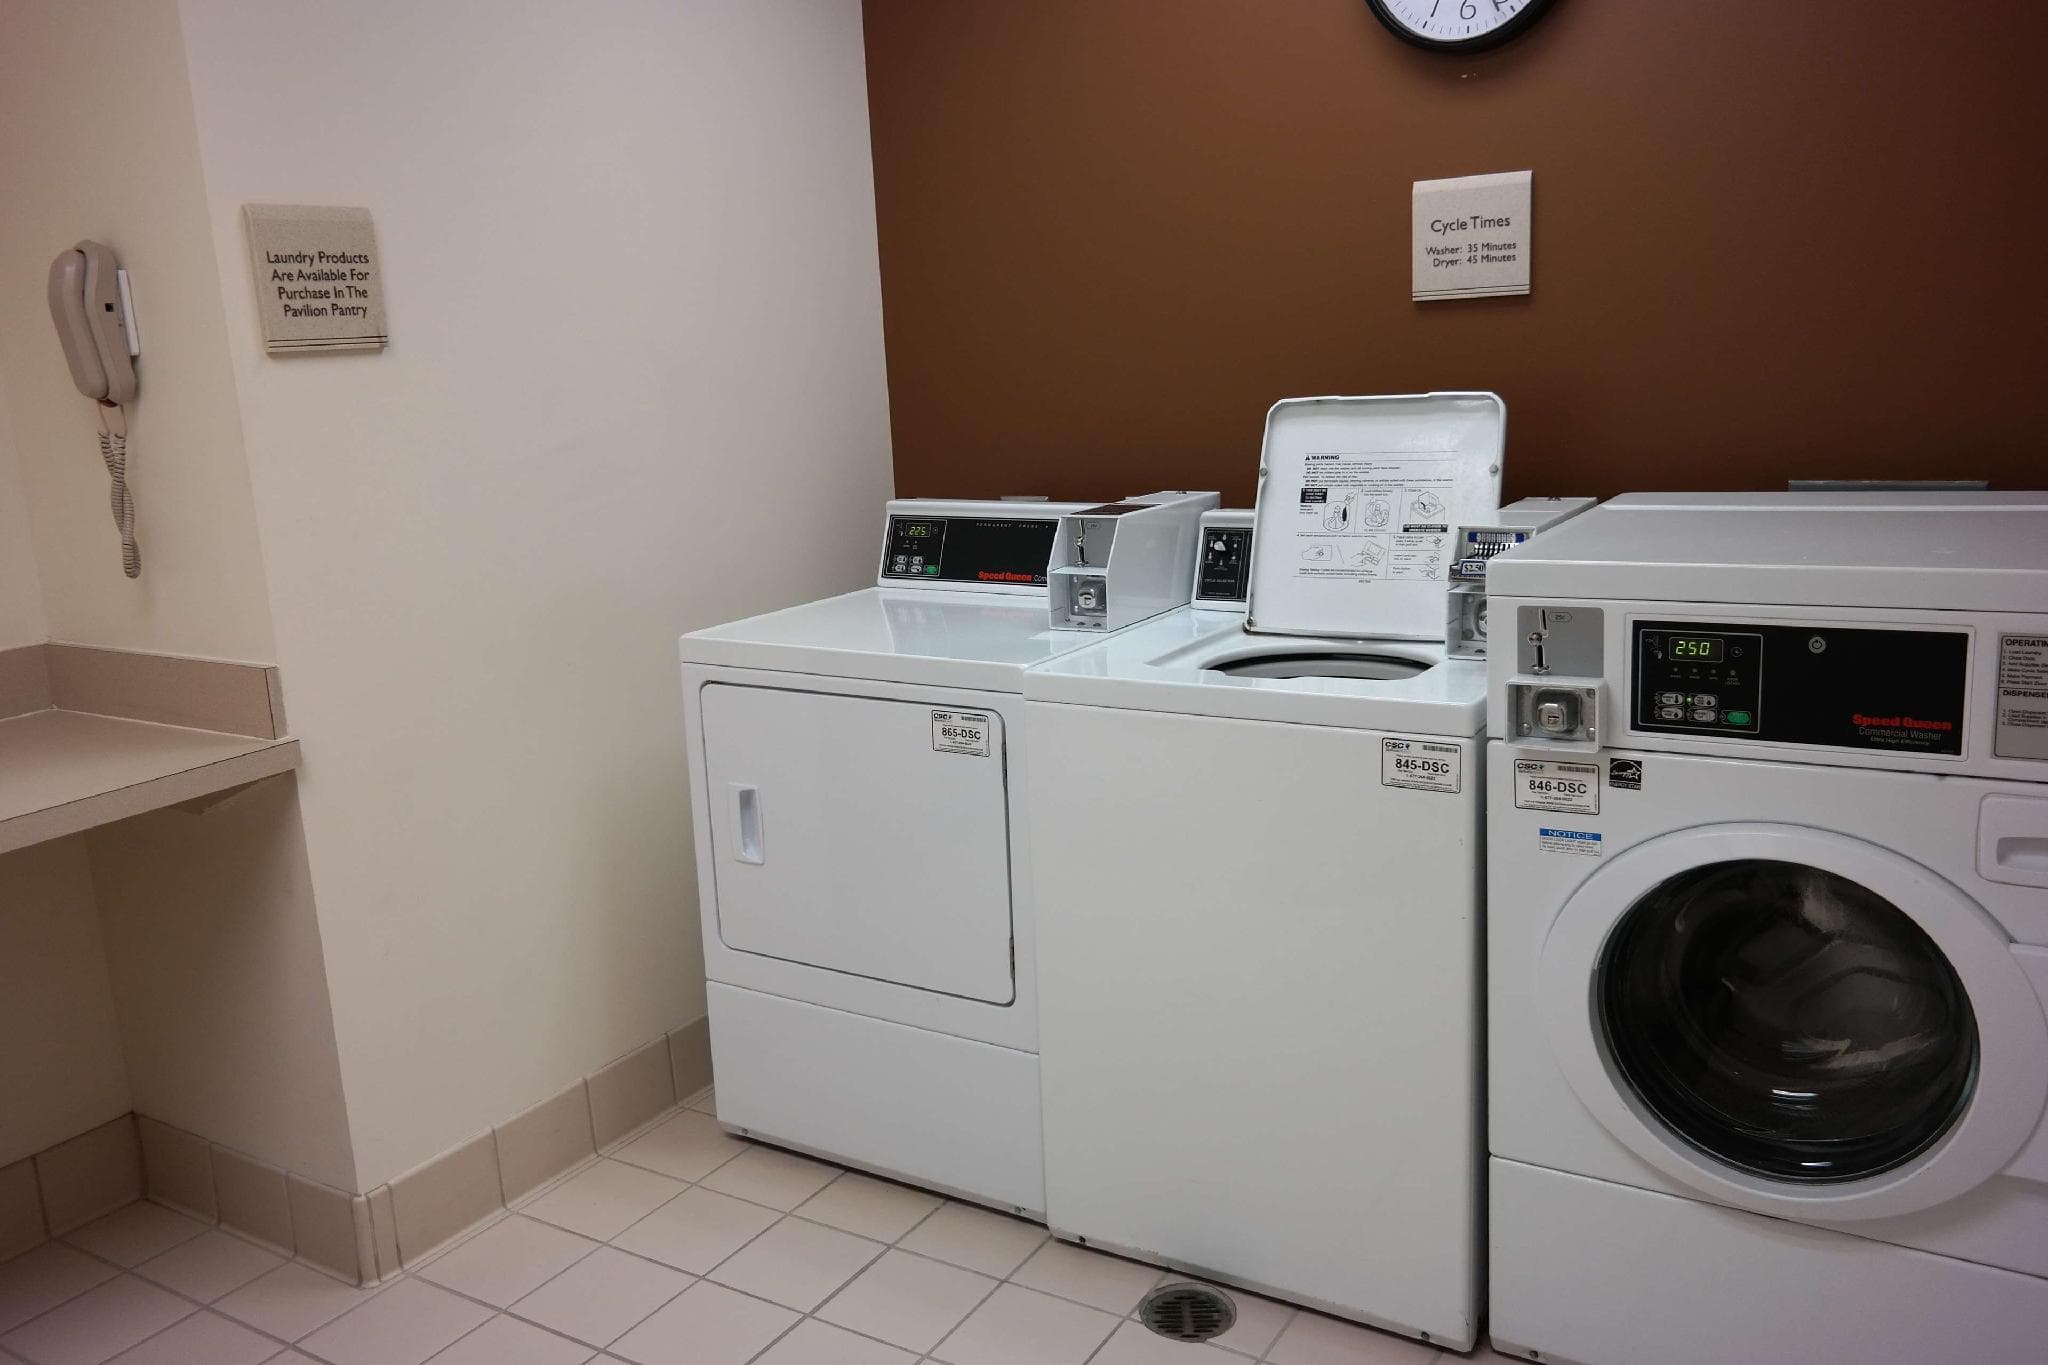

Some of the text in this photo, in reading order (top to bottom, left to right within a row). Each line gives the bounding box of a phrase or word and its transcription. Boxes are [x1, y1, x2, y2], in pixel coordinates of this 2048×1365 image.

[1430, 215, 1511, 236] Cycle Times
[1425, 242, 1517, 256] Washer: 35 Minutes
[266, 250, 370, 267] Laundry Products
[1432, 253, 1517, 269] Dryer: 45 Minutes
[271, 268, 370, 281] Are Available For
[277, 285, 368, 300] Purchase In The
[284, 303, 368, 319] Pavilion Pantry
[909, 525, 926, 536] 225
[1463, 563, 1484, 573] $2.50
[977, 570, 1005, 581] Speed
[1005, 571, 1033, 582] Queen
[1675, 640, 1710, 656] 250
[1852, 713, 1953, 731] Speed Queen
[941, 727, 981, 740] 865-DSC
[1858, 726, 1942, 741] Commercial Washer
[1385, 741, 1405, 749] CSC
[1395, 758, 1450, 774] 845-DSC
[1516, 762, 1538, 770] CSC
[1528, 779, 1587, 794] 846-DSC
[1548, 829, 1594, 840] NOTICE
